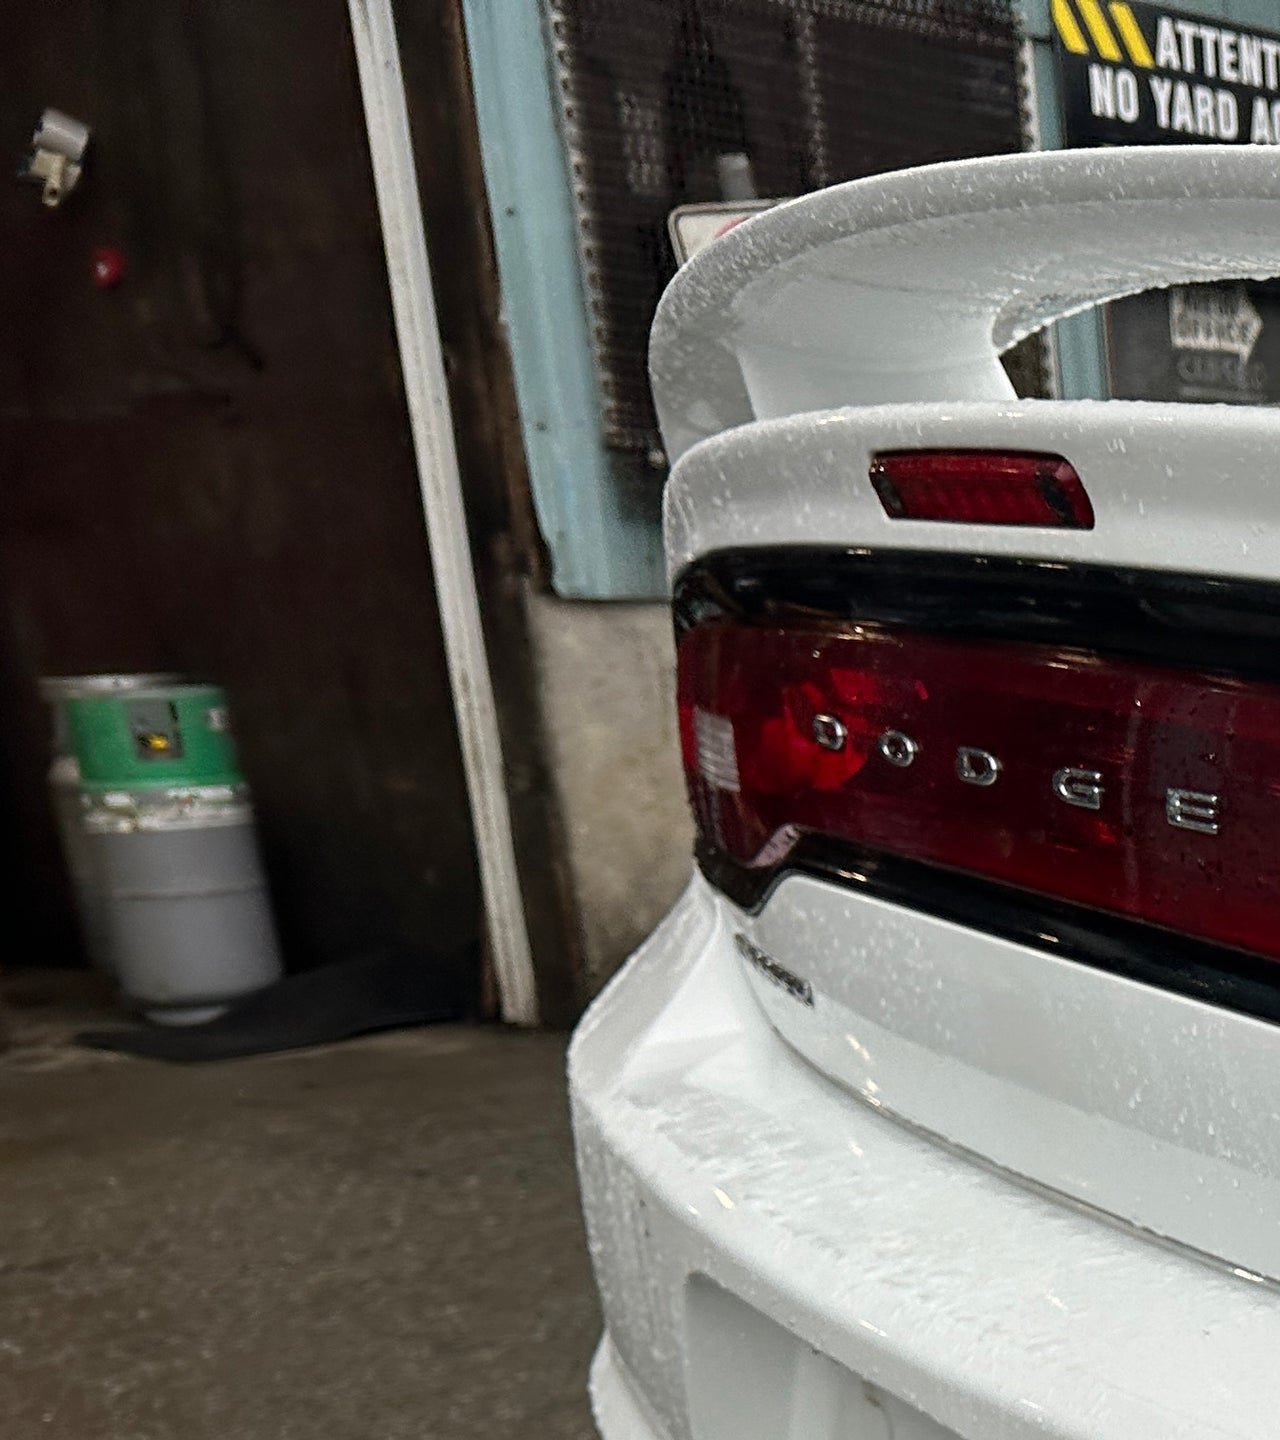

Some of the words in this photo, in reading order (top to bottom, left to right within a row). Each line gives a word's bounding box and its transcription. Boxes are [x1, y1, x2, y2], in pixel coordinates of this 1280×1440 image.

[1088, 62, 1140, 123] NO
[1149, 75, 1239, 141] YARD
[811, 712, 1220, 836] DODGE
